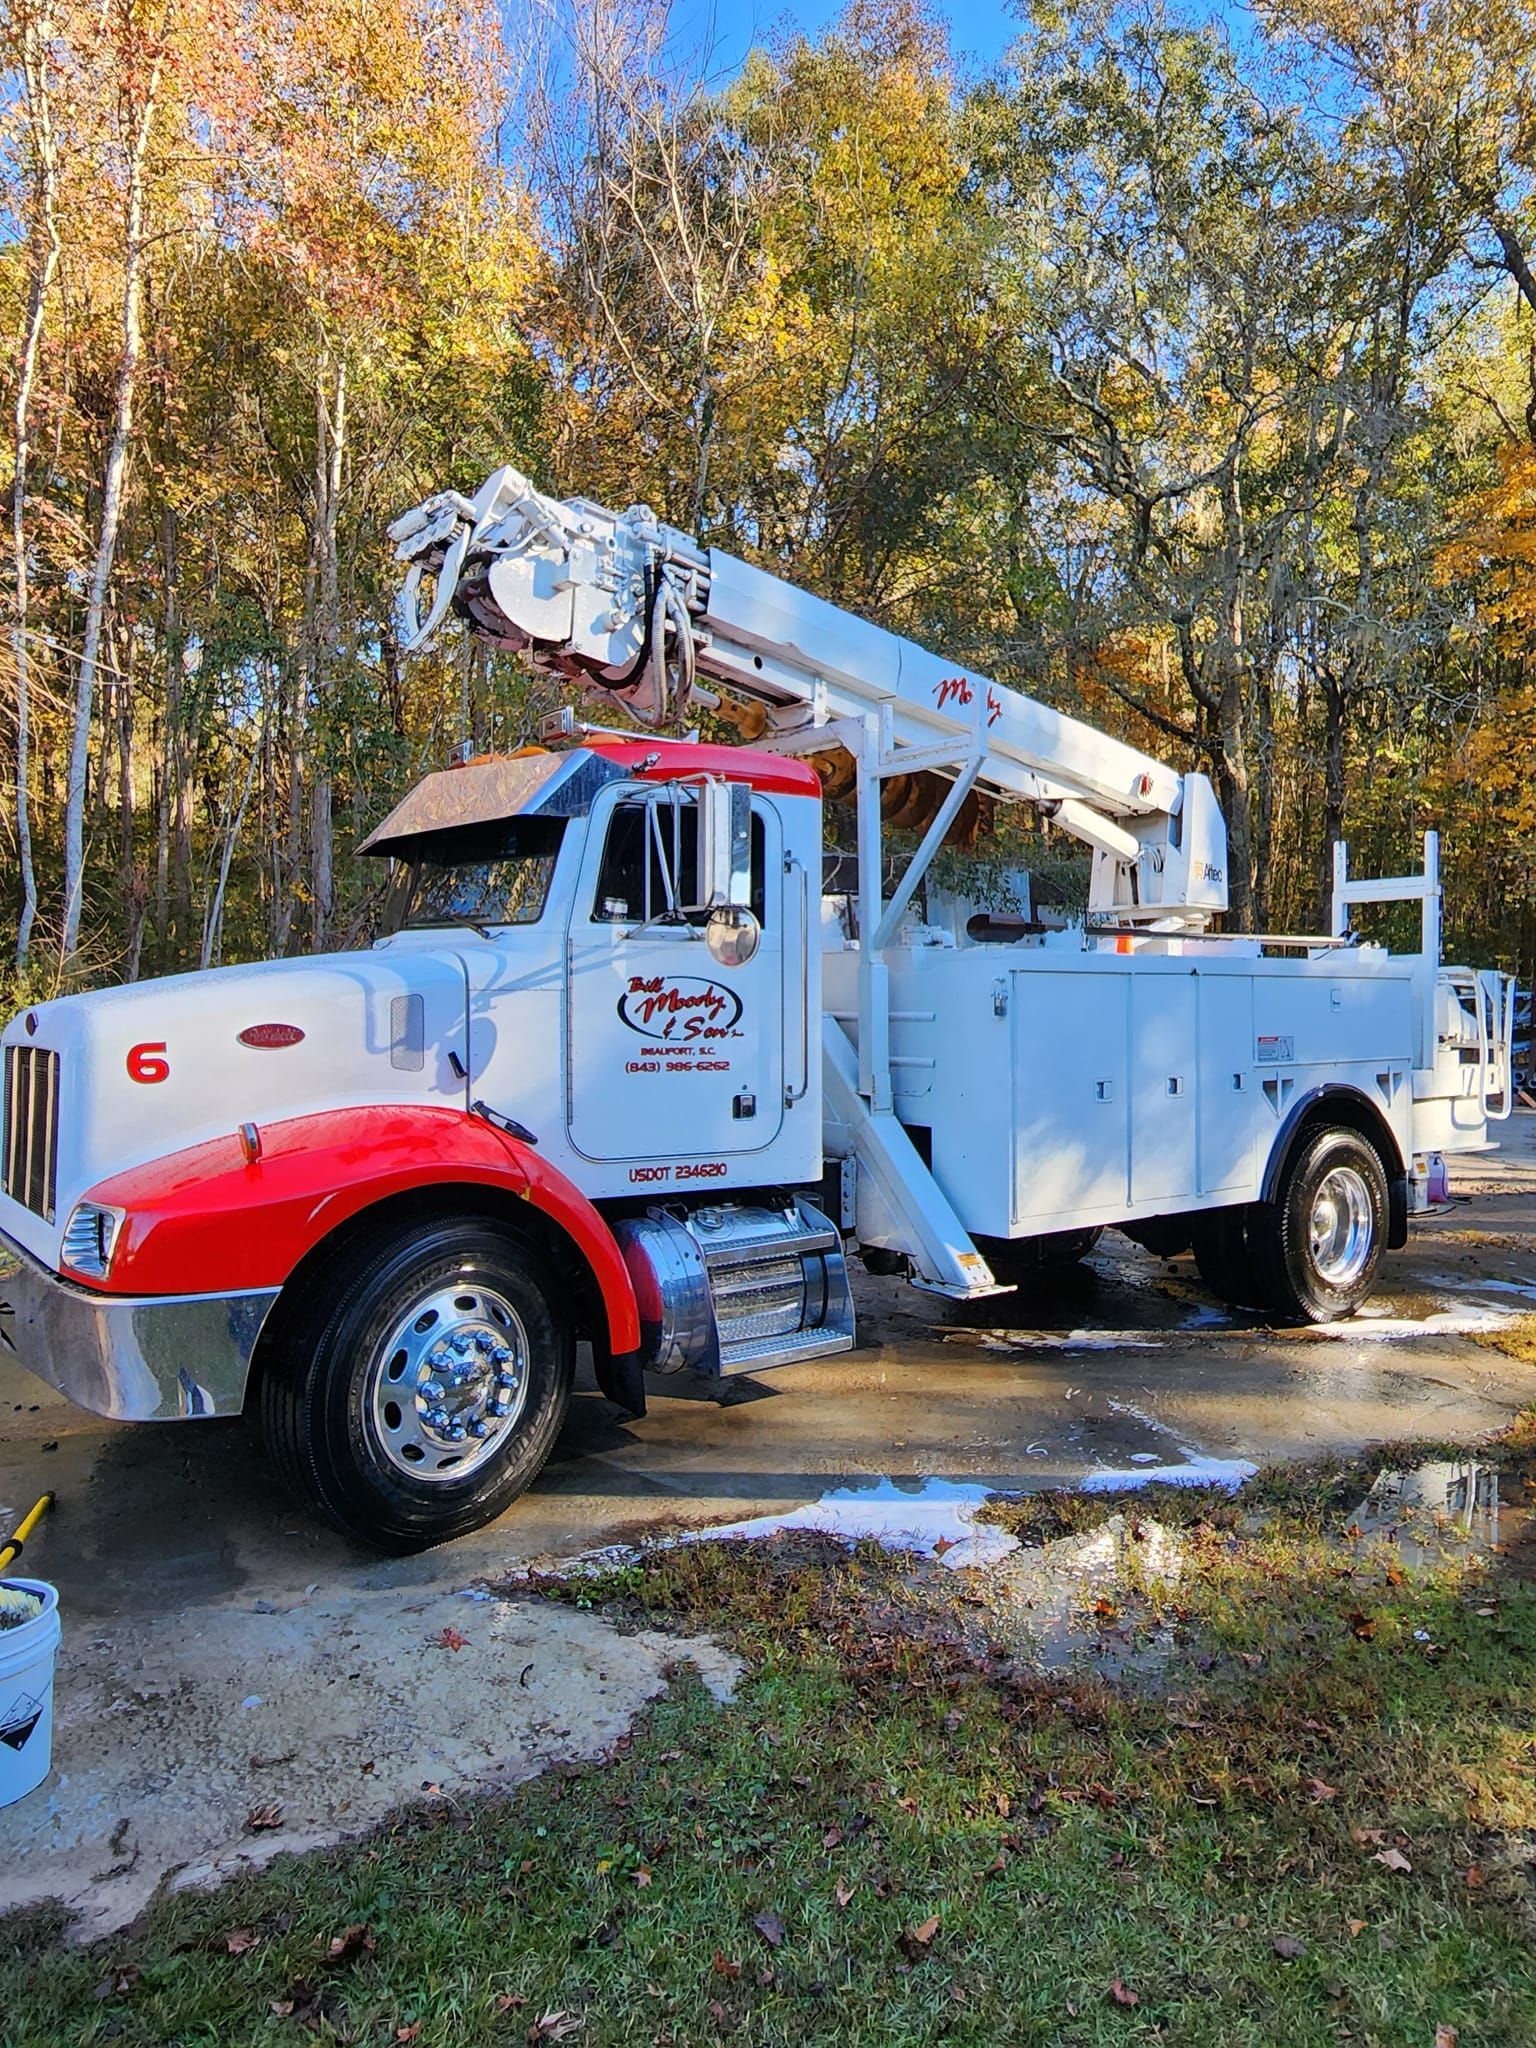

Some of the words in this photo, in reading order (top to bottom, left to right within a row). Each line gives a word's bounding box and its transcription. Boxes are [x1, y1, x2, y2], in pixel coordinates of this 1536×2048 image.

[628, 976, 665, 993] Bill
[634, 985, 727, 1024] Moody
[662, 1016, 677, 1040] &
[127, 1042, 169, 1084] 6
[625, 1061, 661, 1074] (843)
[665, 1061, 730, 1072] 986-6262
[629, 1166, 671, 1183] USDOT
[675, 1162, 727, 1180] 2346210
